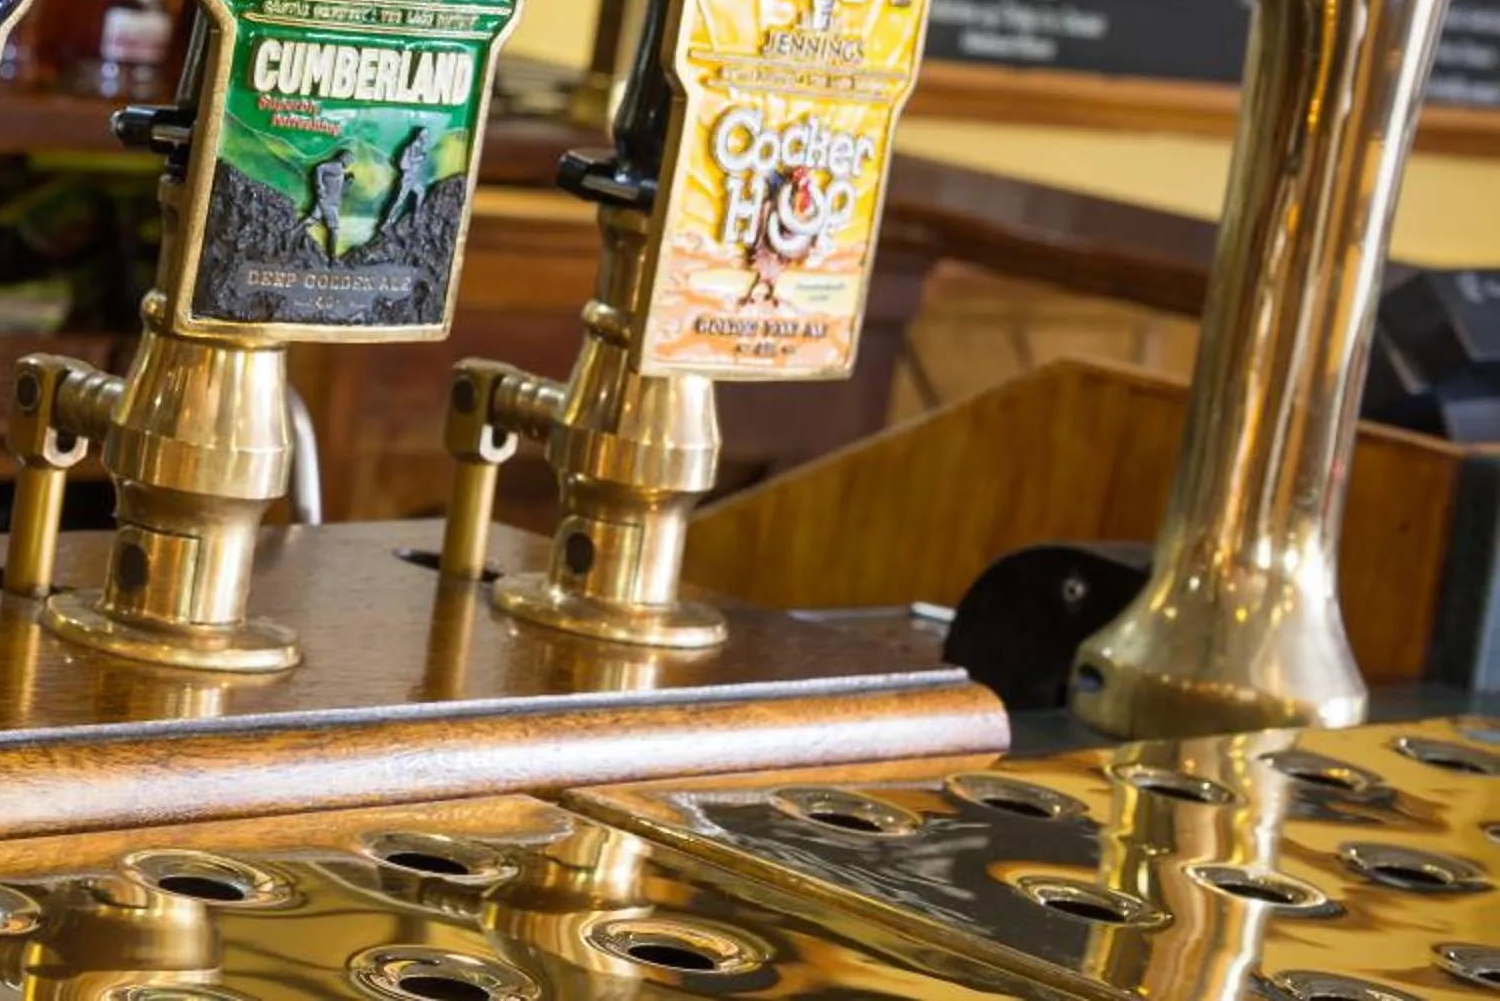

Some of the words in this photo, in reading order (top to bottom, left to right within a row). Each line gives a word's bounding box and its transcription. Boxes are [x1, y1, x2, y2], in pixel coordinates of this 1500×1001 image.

[253, 38, 474, 106] CUMBERLAND
[762, 30, 866, 64] JENNINGS
[715, 106, 875, 176] Cocker
[245, 270, 298, 289] DEEP
[303, 272, 373, 291] GOLDEN
[377, 275, 412, 292] ALE
